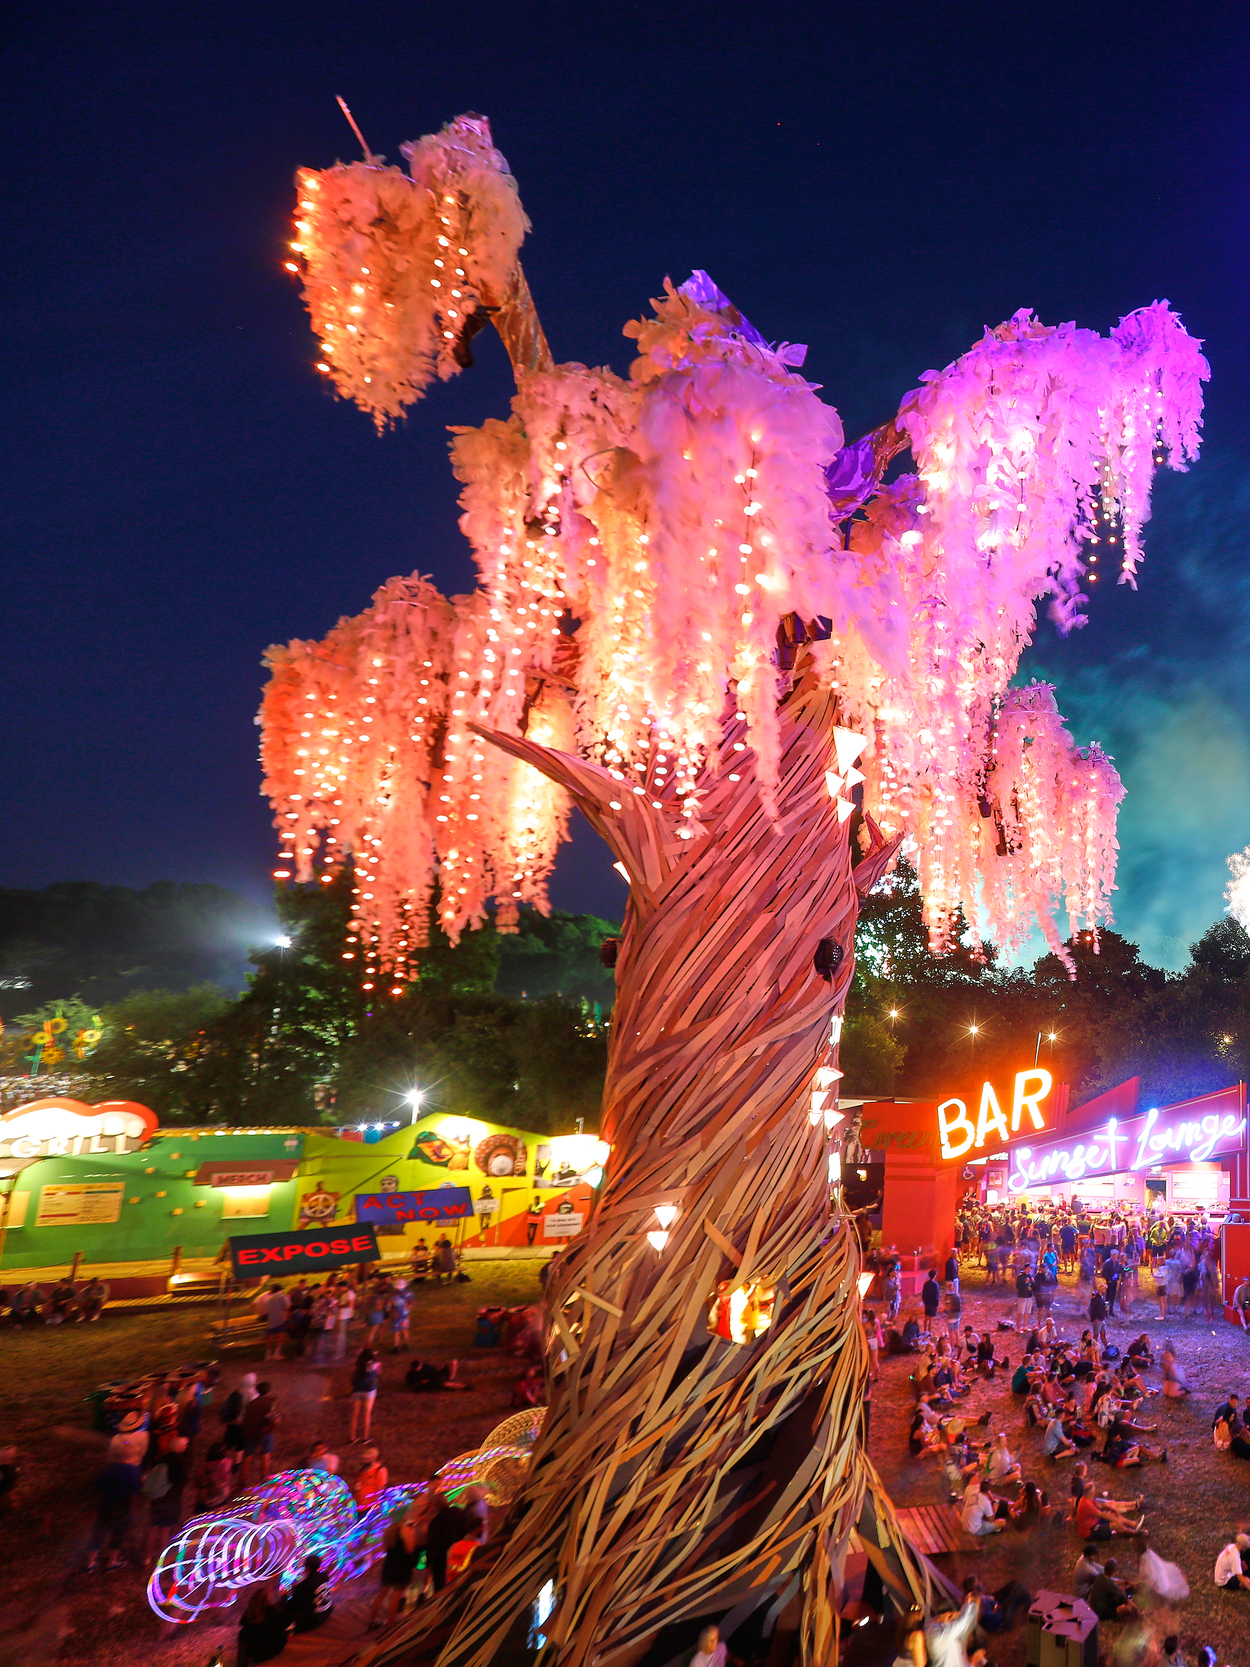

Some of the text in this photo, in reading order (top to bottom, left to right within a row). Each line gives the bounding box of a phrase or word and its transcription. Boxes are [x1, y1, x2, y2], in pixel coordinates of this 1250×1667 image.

[936, 1067, 1053, 1160] BAR
[9, 1133, 133, 1158] GRILL
[1007, 1117, 1128, 1193] Sunset
[1130, 1108, 1247, 1171] Lounge
[217, 1173, 268, 1185] MERCH
[362, 1191, 429, 1210] ACT
[396, 1202, 468, 1221] NOW
[237, 1234, 374, 1266] EXPOSE
